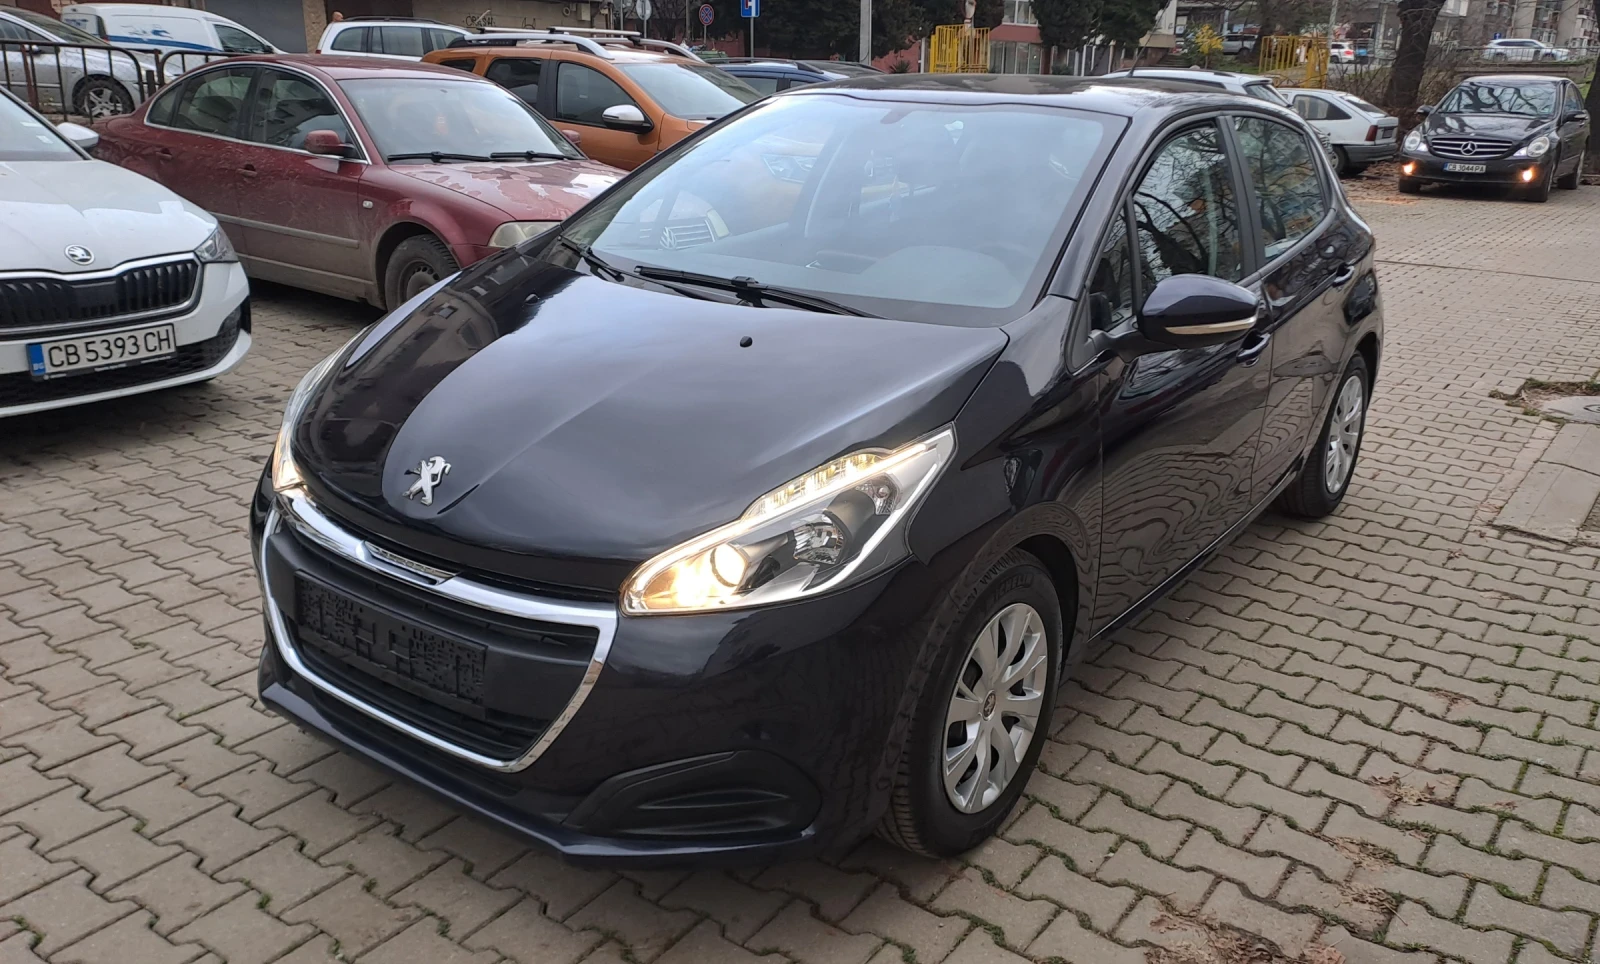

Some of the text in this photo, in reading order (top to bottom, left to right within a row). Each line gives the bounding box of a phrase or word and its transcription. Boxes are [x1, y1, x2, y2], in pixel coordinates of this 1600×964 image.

[1457, 164, 1475, 172] 3044
[47, 328, 171, 368] CB 5393 CH
